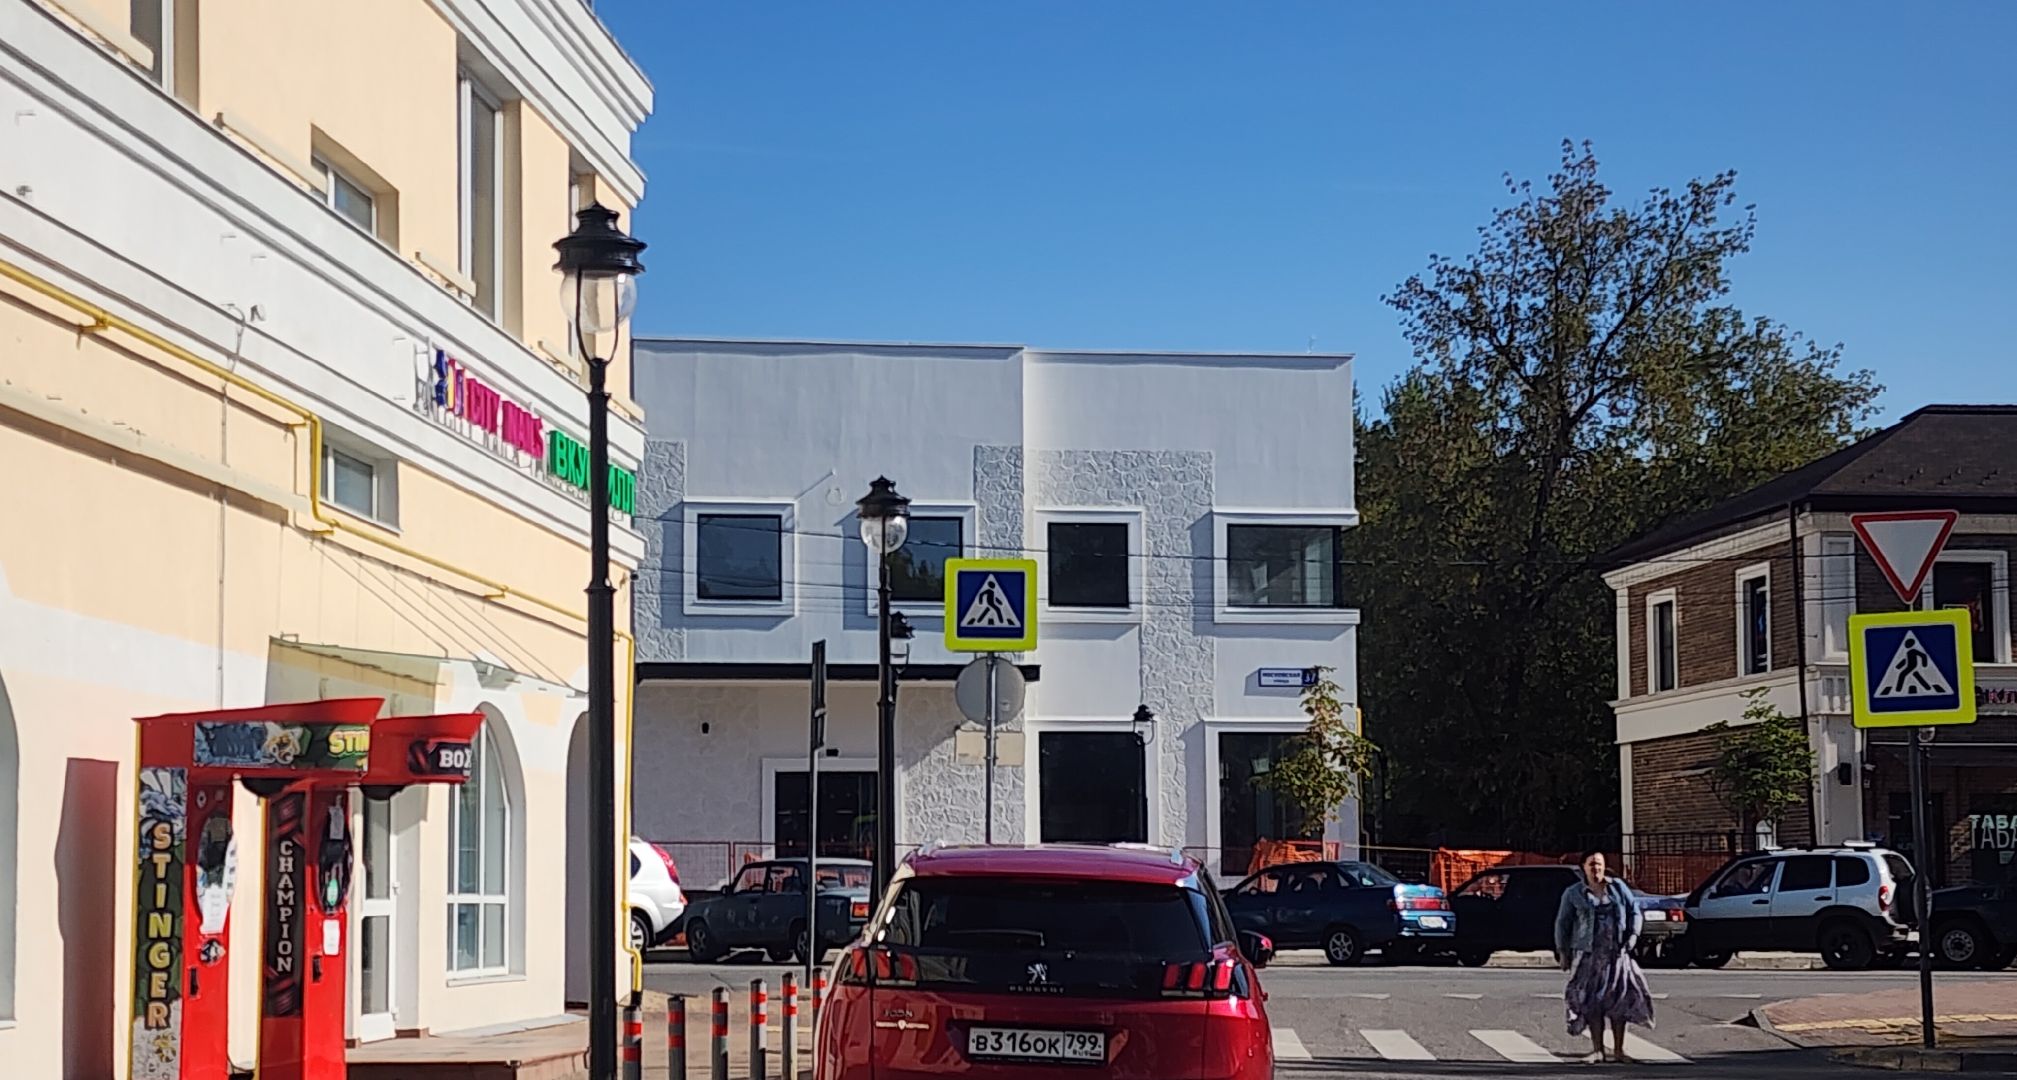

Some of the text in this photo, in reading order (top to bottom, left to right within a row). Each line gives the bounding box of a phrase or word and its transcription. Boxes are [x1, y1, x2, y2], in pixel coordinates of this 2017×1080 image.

[147, 822, 172, 1028] STINGER
[277, 840, 295, 972] CHAMPION
[1066, 1033, 1098, 1051] 799
